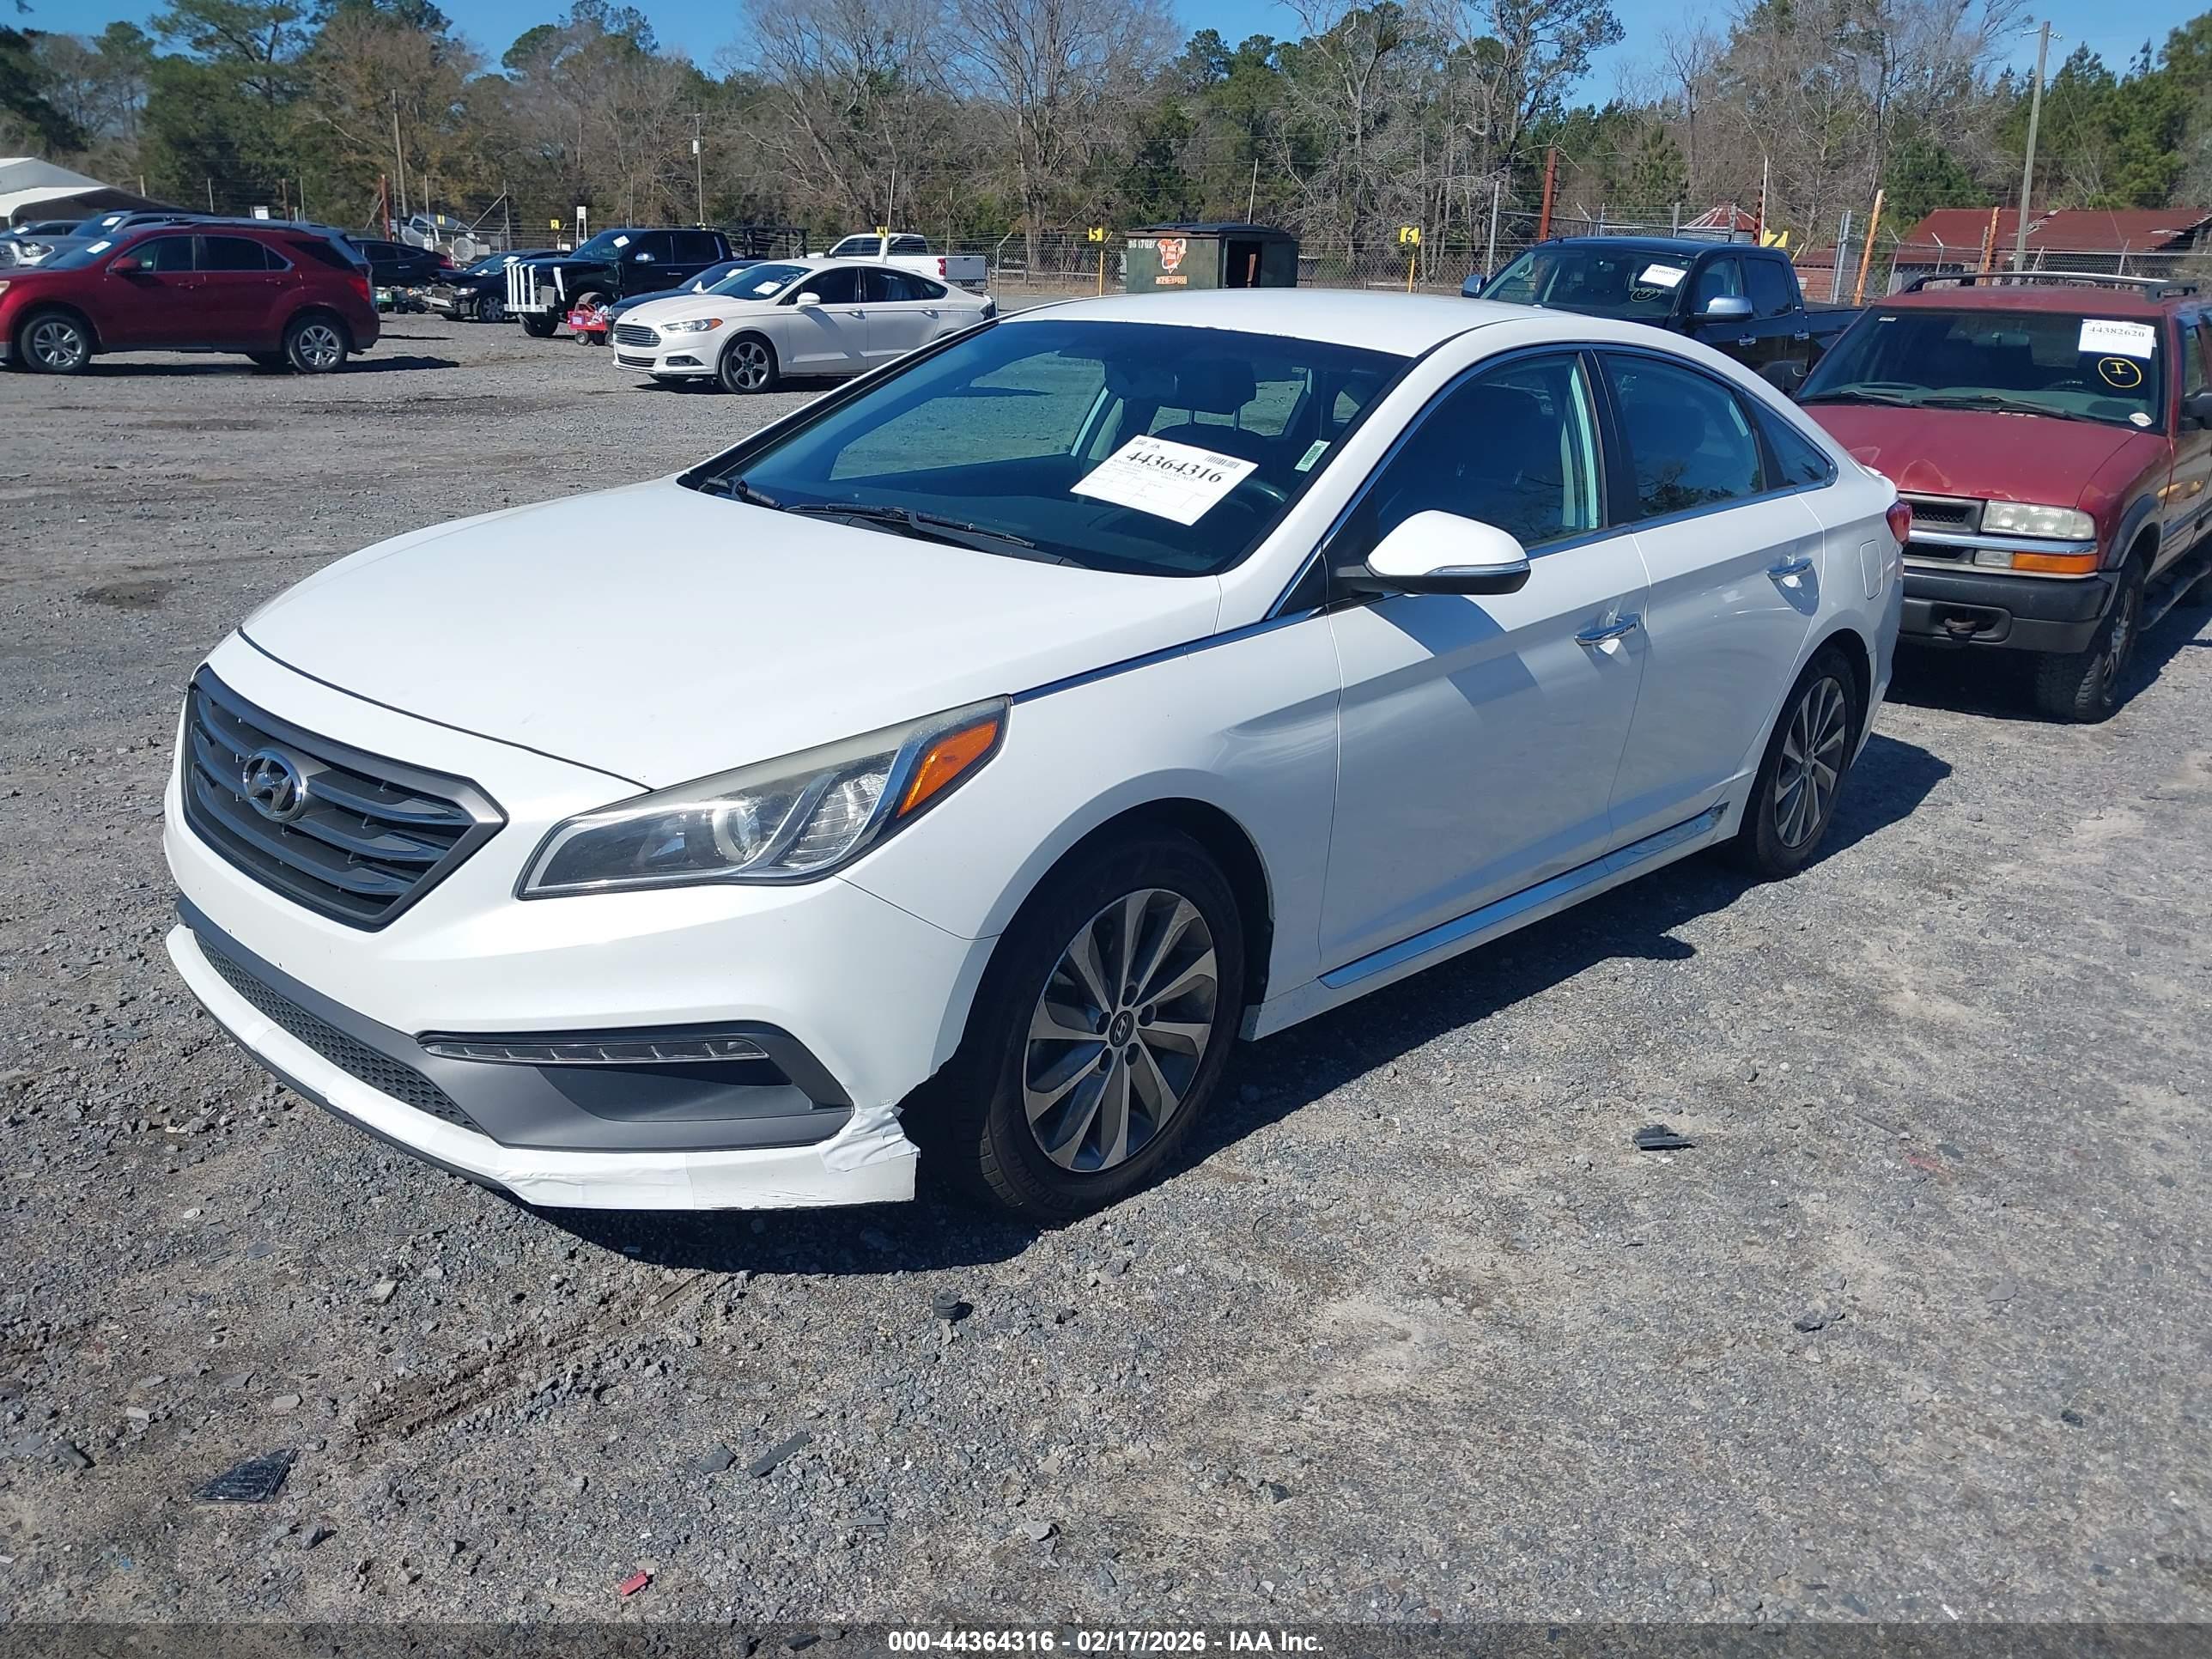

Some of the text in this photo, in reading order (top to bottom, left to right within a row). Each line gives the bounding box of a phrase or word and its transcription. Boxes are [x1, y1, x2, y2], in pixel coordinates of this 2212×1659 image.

[1091, 228, 1099, 241] 5
[1406, 227, 1415, 242] 6
[1766, 229, 1784, 248] 7
[2088, 326, 2145, 337] 44382620
[1126, 451, 1229, 483] 44364316
